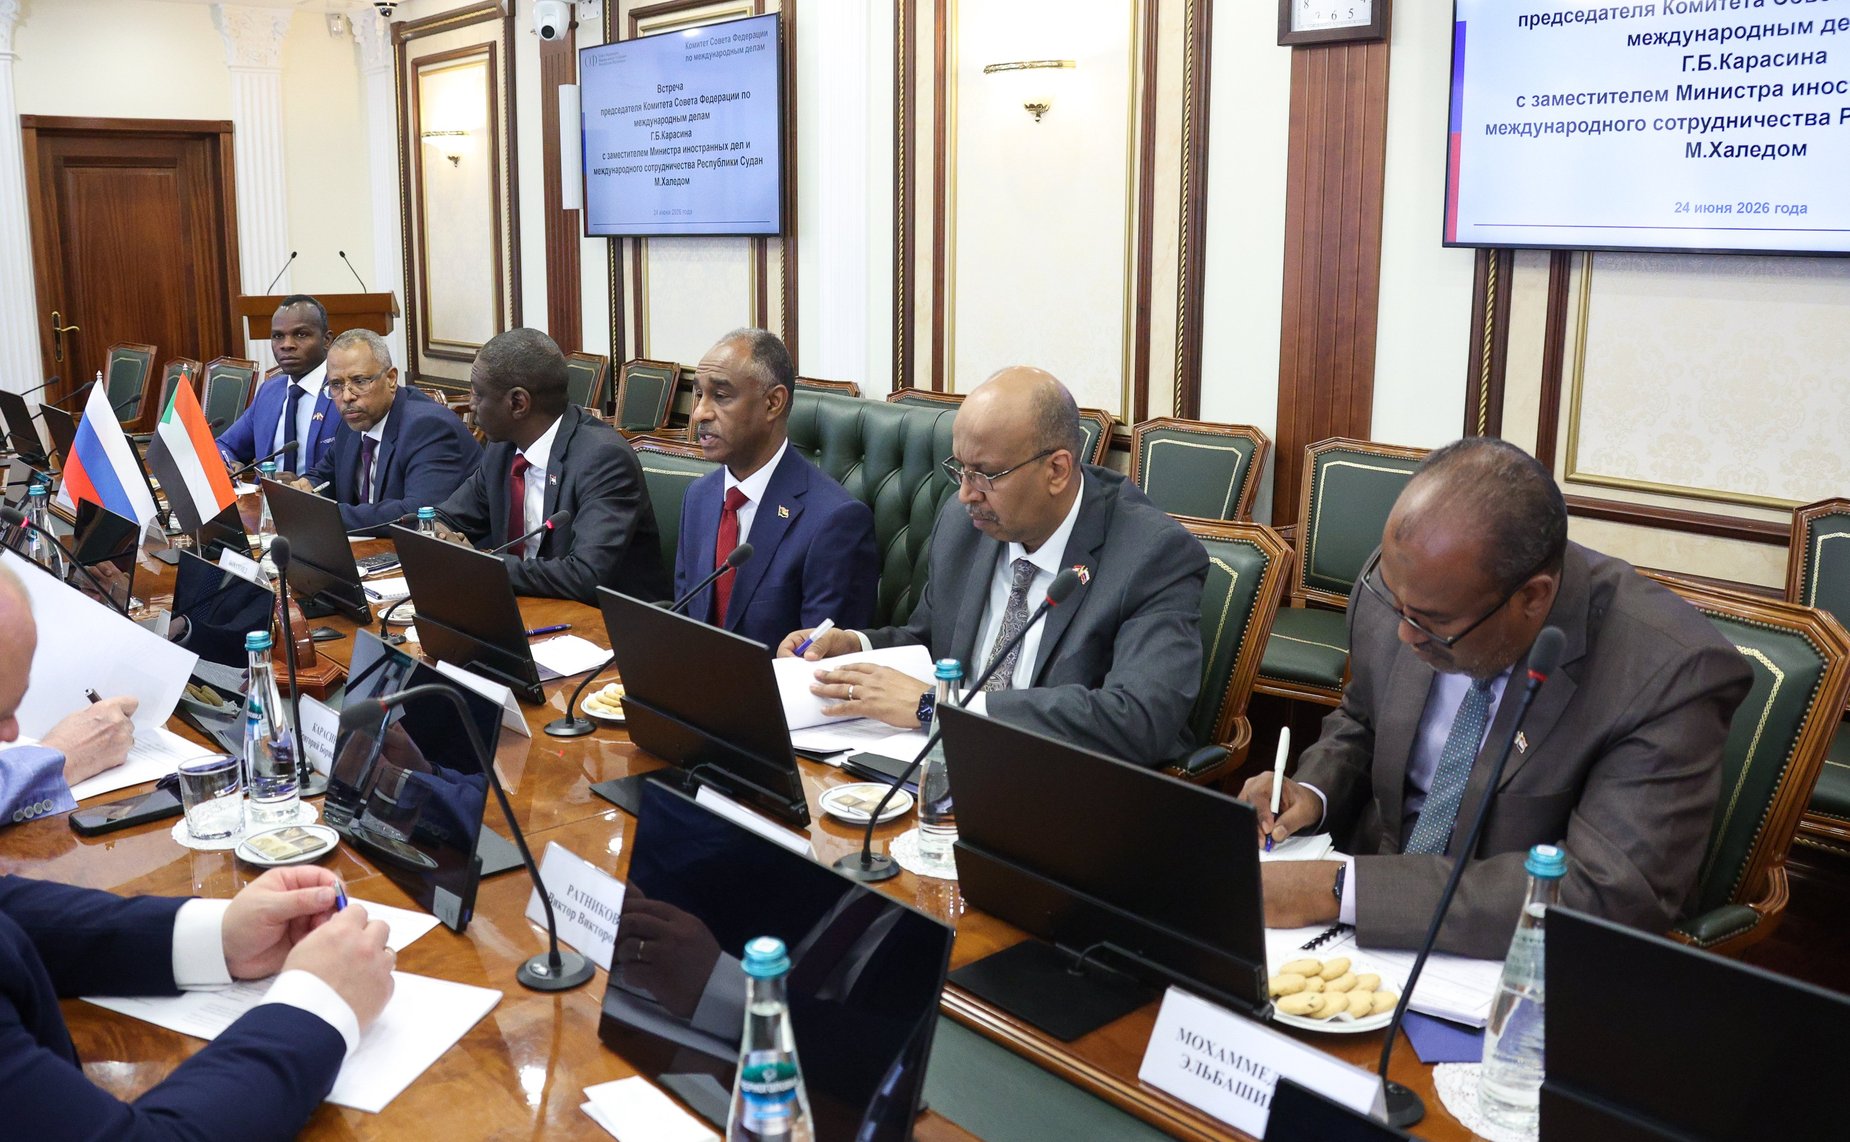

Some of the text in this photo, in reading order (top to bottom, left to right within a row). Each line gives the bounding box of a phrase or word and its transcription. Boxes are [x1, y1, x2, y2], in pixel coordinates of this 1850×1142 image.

[1518, 4, 1656, 30] председателя
[1627, 20, 1813, 48] международным
[1682, 50, 1828, 73] Г.Б.Карасина
[657, 83, 684, 94] Встреча
[1516, 95, 1526, 108] с
[1531, 89, 1669, 108] заместителем
[1676, 83, 1784, 102] Министра
[600, 90, 751, 118] председателя Комитета Совета Федерации по
[634, 112, 710, 128] международным делам
[1485, 118, 1646, 138] международного
[1653, 112, 1830, 134] сотрудничества
[650, 130, 692, 141] Г.Б.Карасина
[607, 148, 649, 160] заместителем
[650, 146, 681, 156] Министра
[682, 142, 728, 154] иностранных
[730, 141, 744, 151] дел
[746, 141, 751, 150] и
[1685, 141, 1807, 160] М.Халедом
[594, 156, 764, 176] международного сотрудничества Республики Судан
[654, 176, 690, 187] М.Халедом
[1674, 202, 1808, 216] 24 июня 2026 года
[1179, 1053, 1270, 1107] ЭЛЬБАШИ
